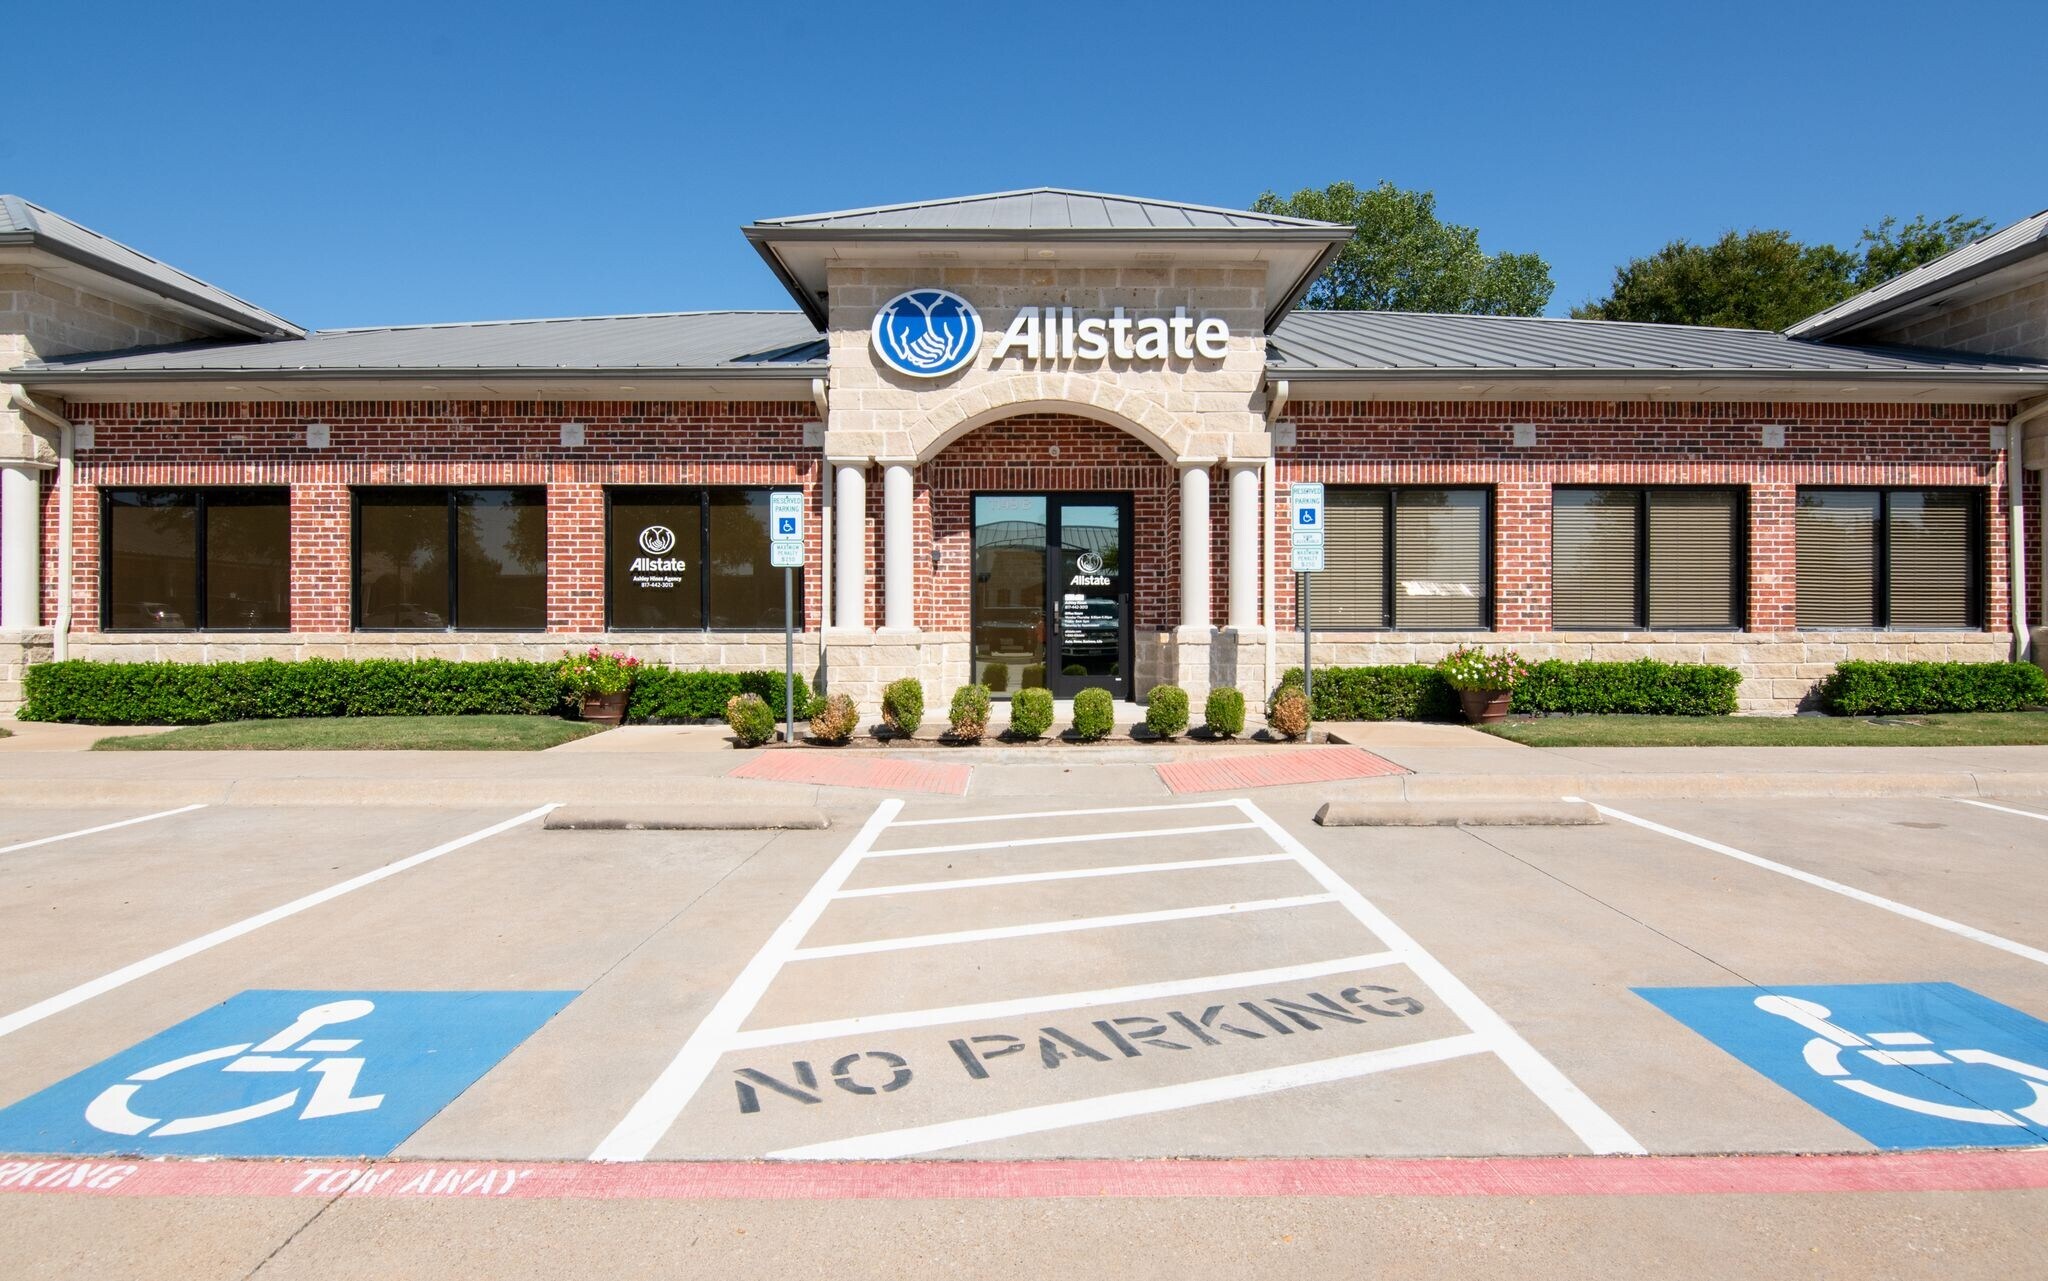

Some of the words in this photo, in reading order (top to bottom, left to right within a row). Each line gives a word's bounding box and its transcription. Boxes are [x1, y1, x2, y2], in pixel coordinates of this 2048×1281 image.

[992, 306, 1230, 360] Allstate
[629, 557, 686, 572] Allstate
[1070, 575, 1111, 586] Allstate
[734, 1050, 913, 1114] NO
[947, 985, 1425, 1080] PARKING
[291, 1167, 392, 1194] TOW
[400, 1168, 533, 1195] AWAY
